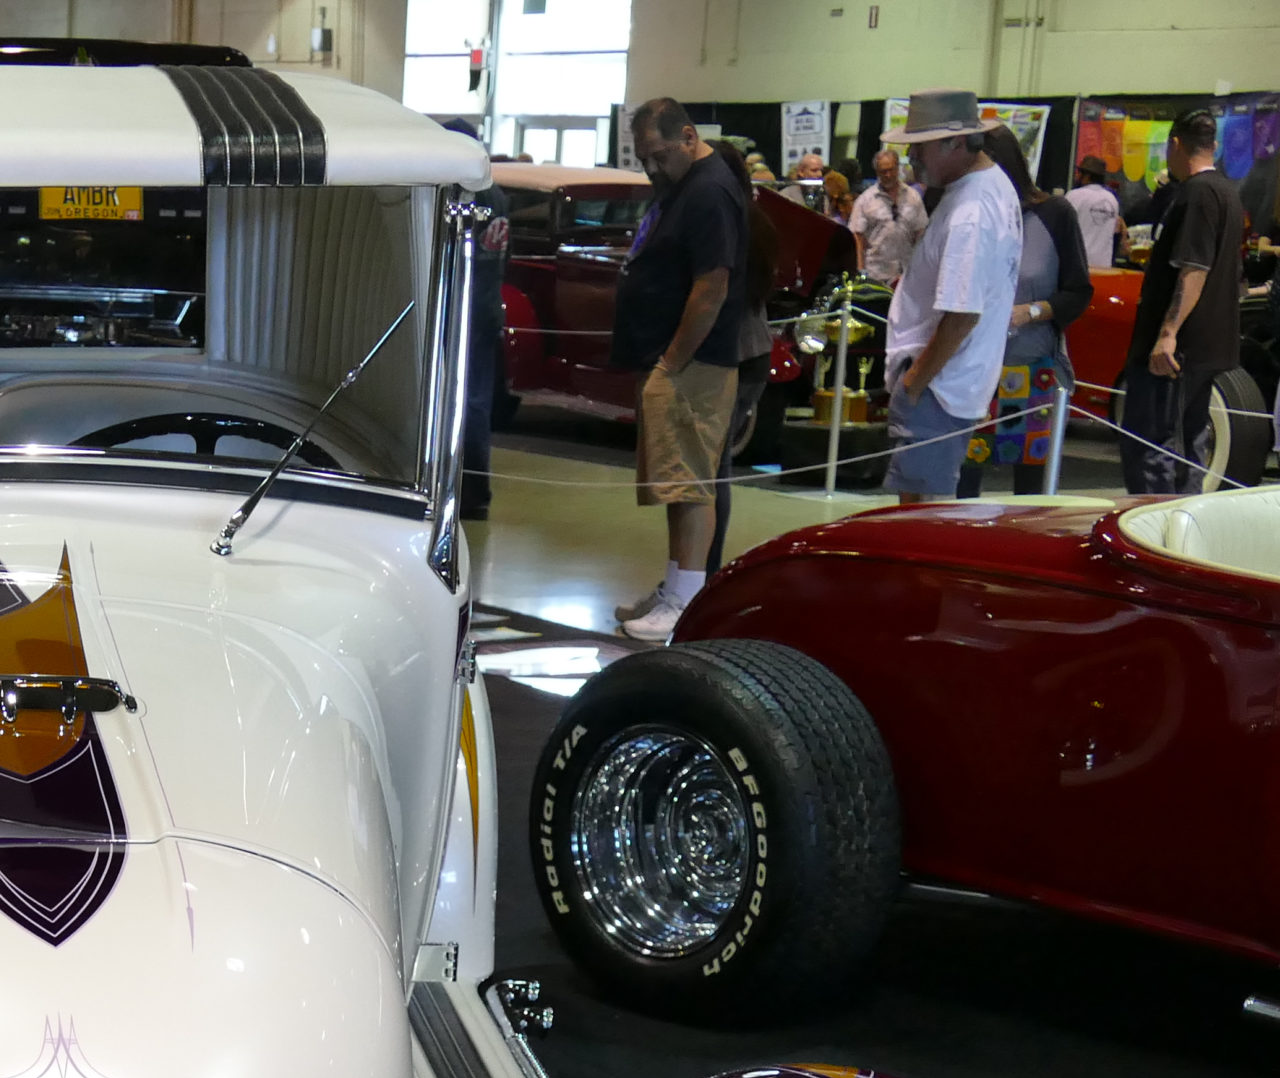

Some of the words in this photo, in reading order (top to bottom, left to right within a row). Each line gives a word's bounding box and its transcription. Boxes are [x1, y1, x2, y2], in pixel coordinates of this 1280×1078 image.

[65, 208, 118, 217] OREGON
[553, 724, 588, 770] T/A
[540, 783, 570, 914] Radial
[702, 747, 768, 976] BFGoodrich
